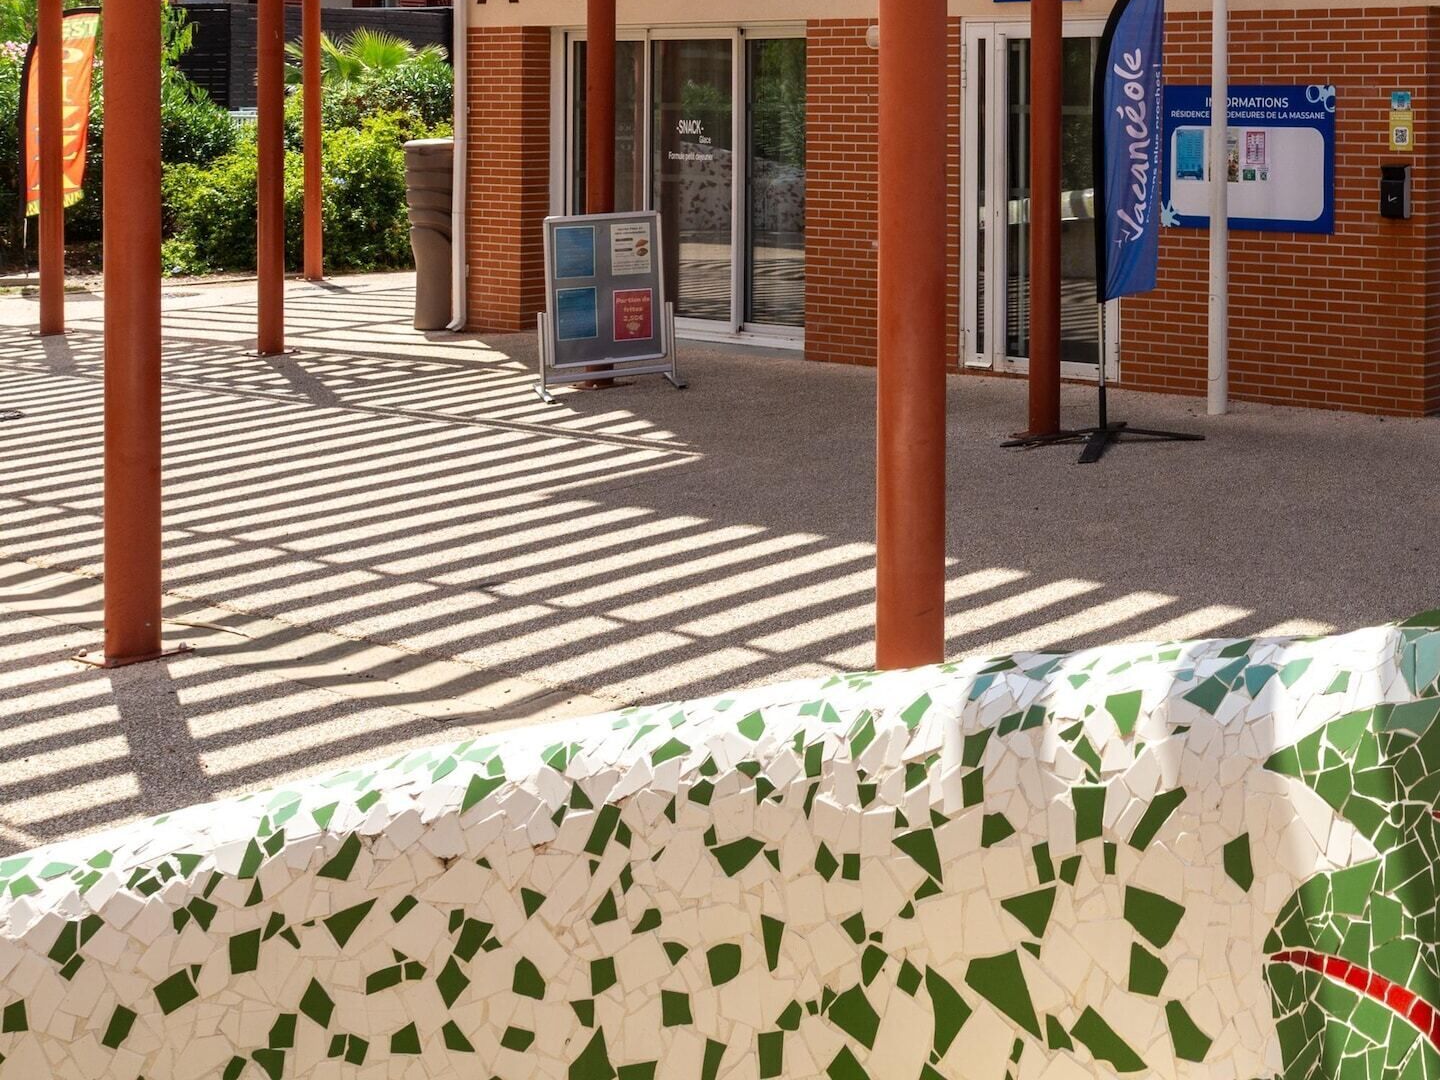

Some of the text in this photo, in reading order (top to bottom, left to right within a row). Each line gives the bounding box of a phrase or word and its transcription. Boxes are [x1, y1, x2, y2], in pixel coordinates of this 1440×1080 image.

[1114, 47, 1150, 241] Vacancéole
[1171, 109, 1210, 118] RÉSIDENCE
[1267, 111, 1276, 119] DE
[1278, 111, 1288, 119] LA
